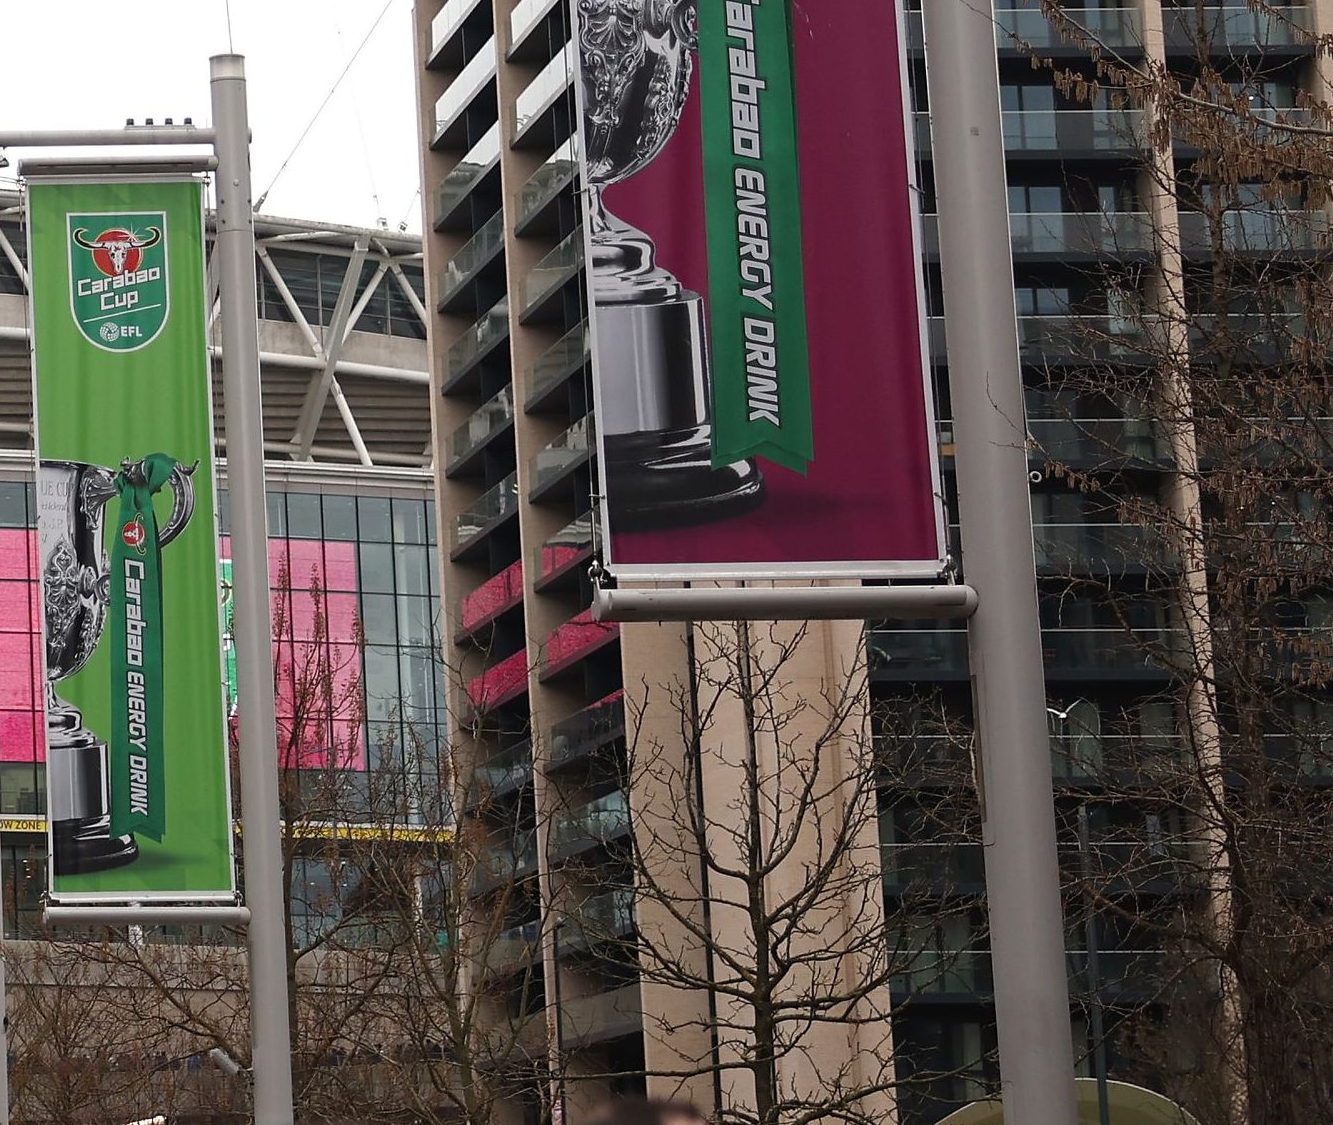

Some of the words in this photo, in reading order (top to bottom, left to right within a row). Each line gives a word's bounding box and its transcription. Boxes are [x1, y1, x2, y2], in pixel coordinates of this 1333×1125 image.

[734, 167, 773, 312] ENERGY
[78, 266, 161, 296] Carabao
[100, 291, 139, 311] Cup
[120, 326, 143, 338] EFL
[743, 317, 780, 427] DRINK
[125, 558, 147, 667] Carabao
[127, 671, 147, 752] ENERGY
[129, 754, 149, 816] DRINK
[16, 820, 41, 830] ZONE
